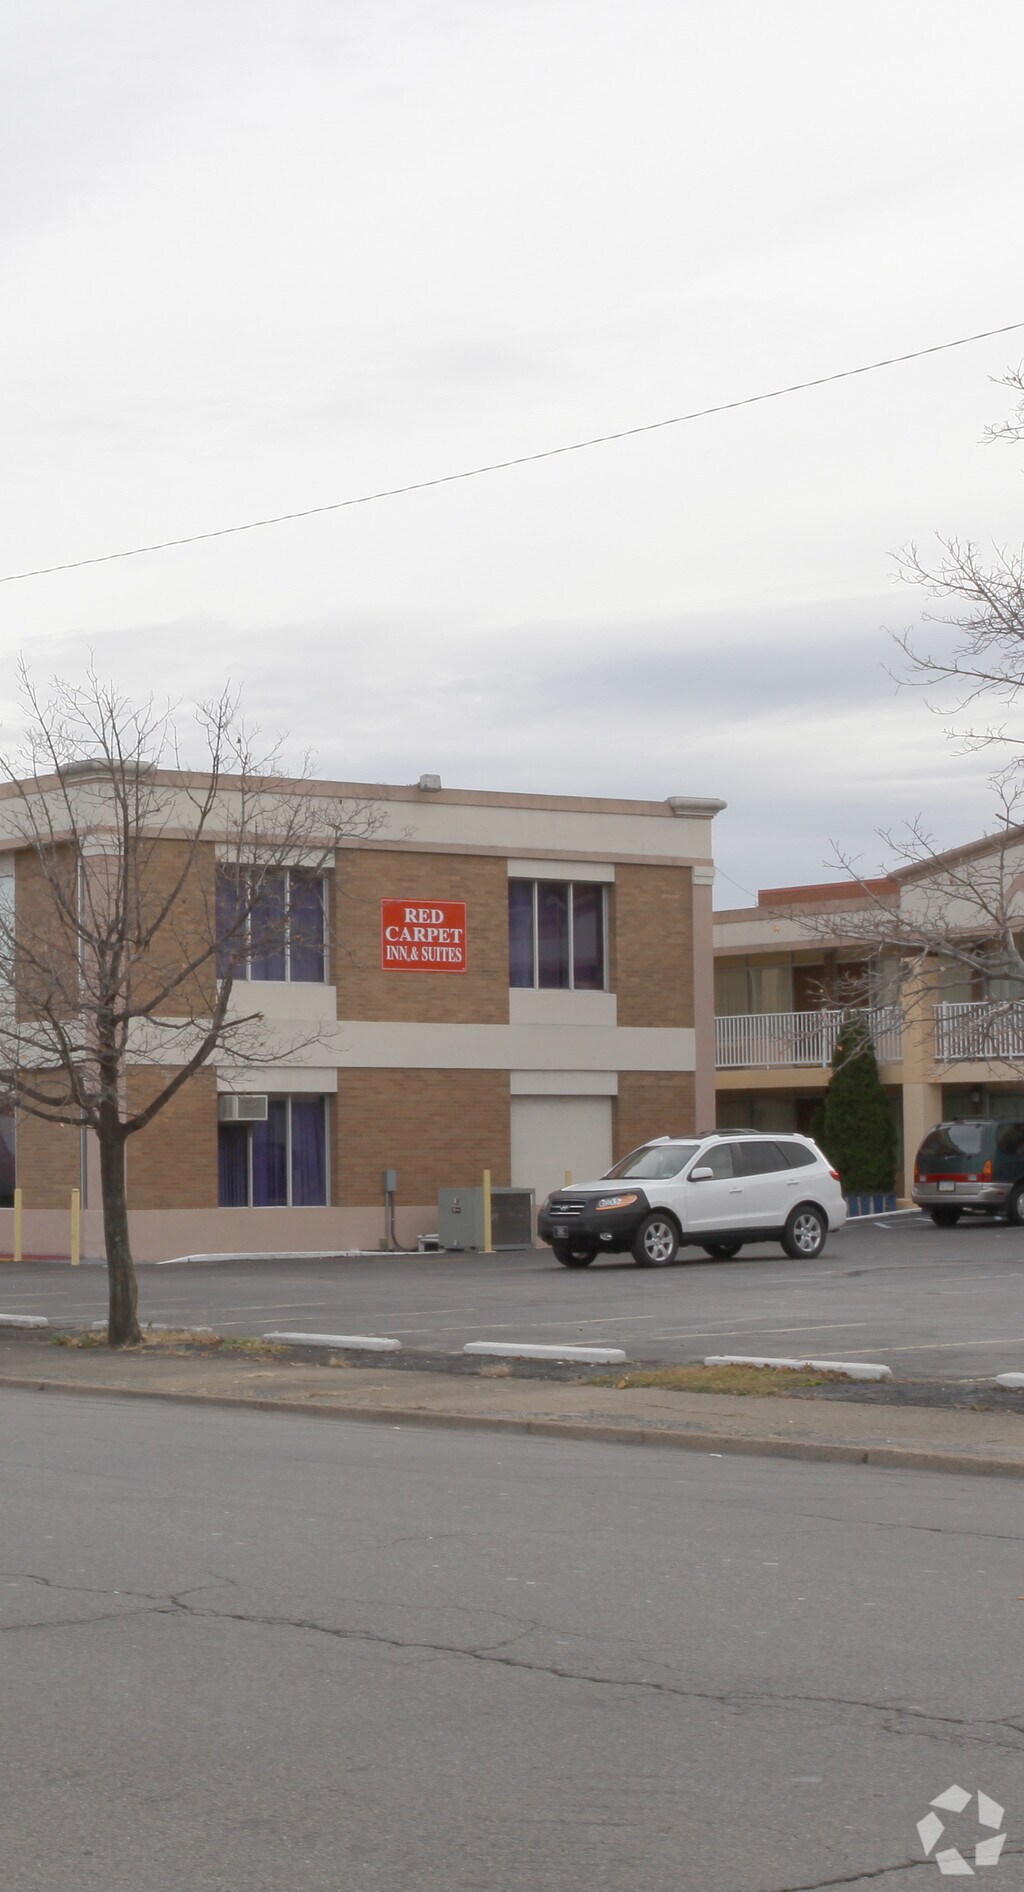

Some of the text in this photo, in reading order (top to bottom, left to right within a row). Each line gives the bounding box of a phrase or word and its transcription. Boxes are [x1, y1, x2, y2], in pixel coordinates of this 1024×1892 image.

[404, 907, 444, 924] RED
[385, 926, 463, 944] CARPET
[421, 946, 462, 963] SUITES
